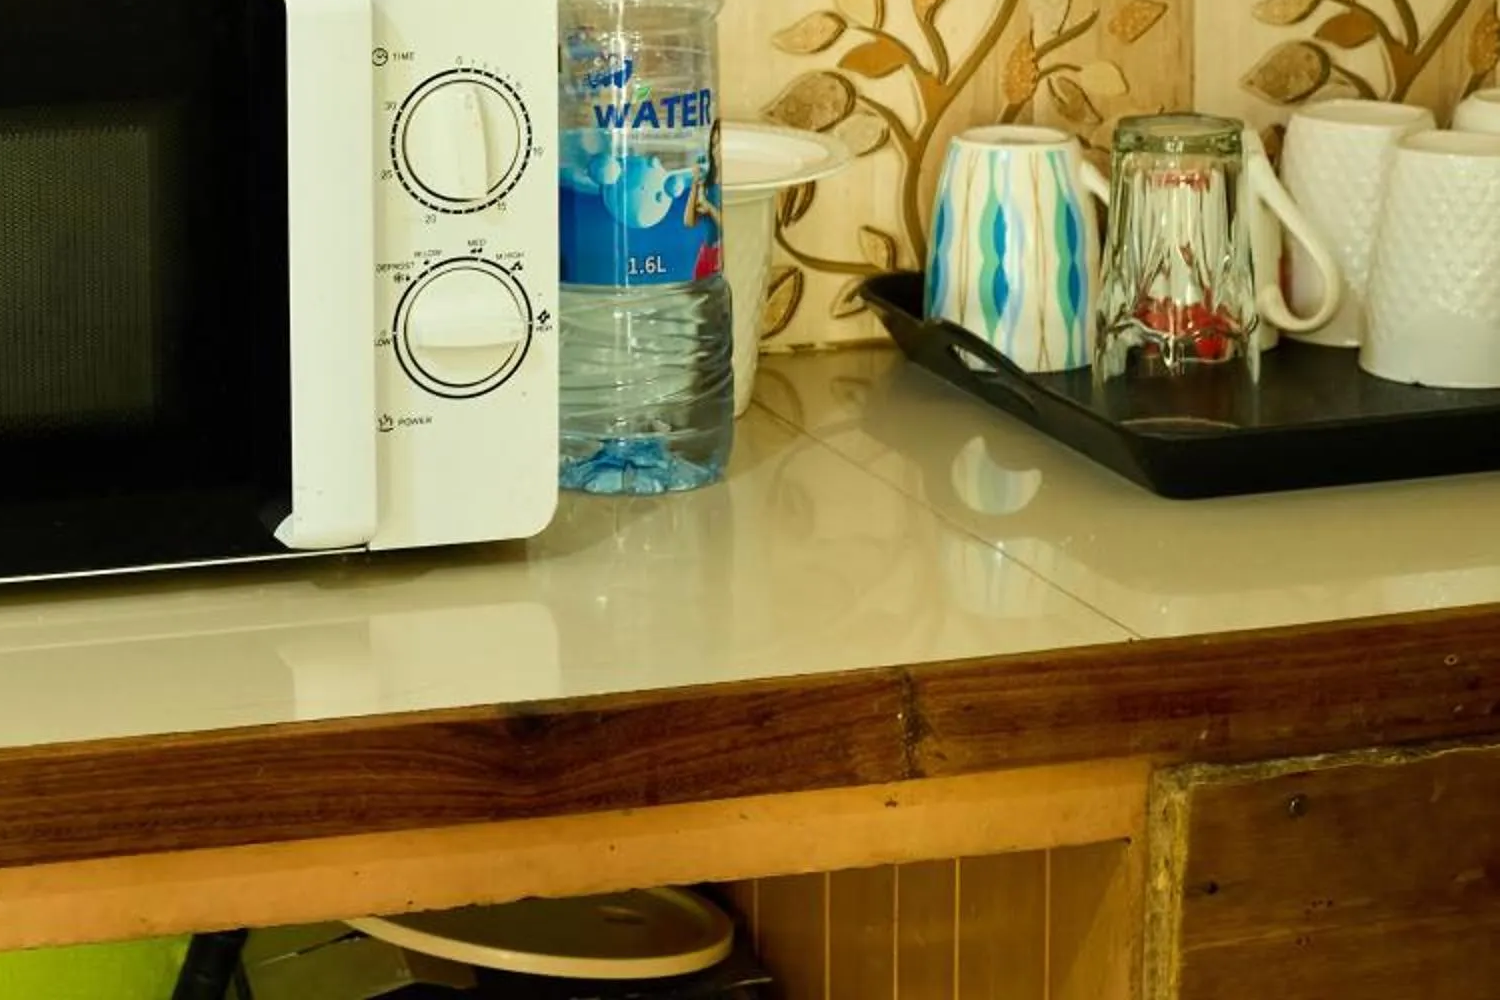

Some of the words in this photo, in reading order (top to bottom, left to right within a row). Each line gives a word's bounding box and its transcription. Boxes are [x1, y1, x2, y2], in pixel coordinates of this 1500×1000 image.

[392, 52, 414, 61] TIME
[594, 88, 711, 129] WATER
[425, 215, 437, 224] 20
[467, 239, 487, 247] MED
[628, 256, 666, 275] 1.6L
[397, 415, 433, 426] POWER
